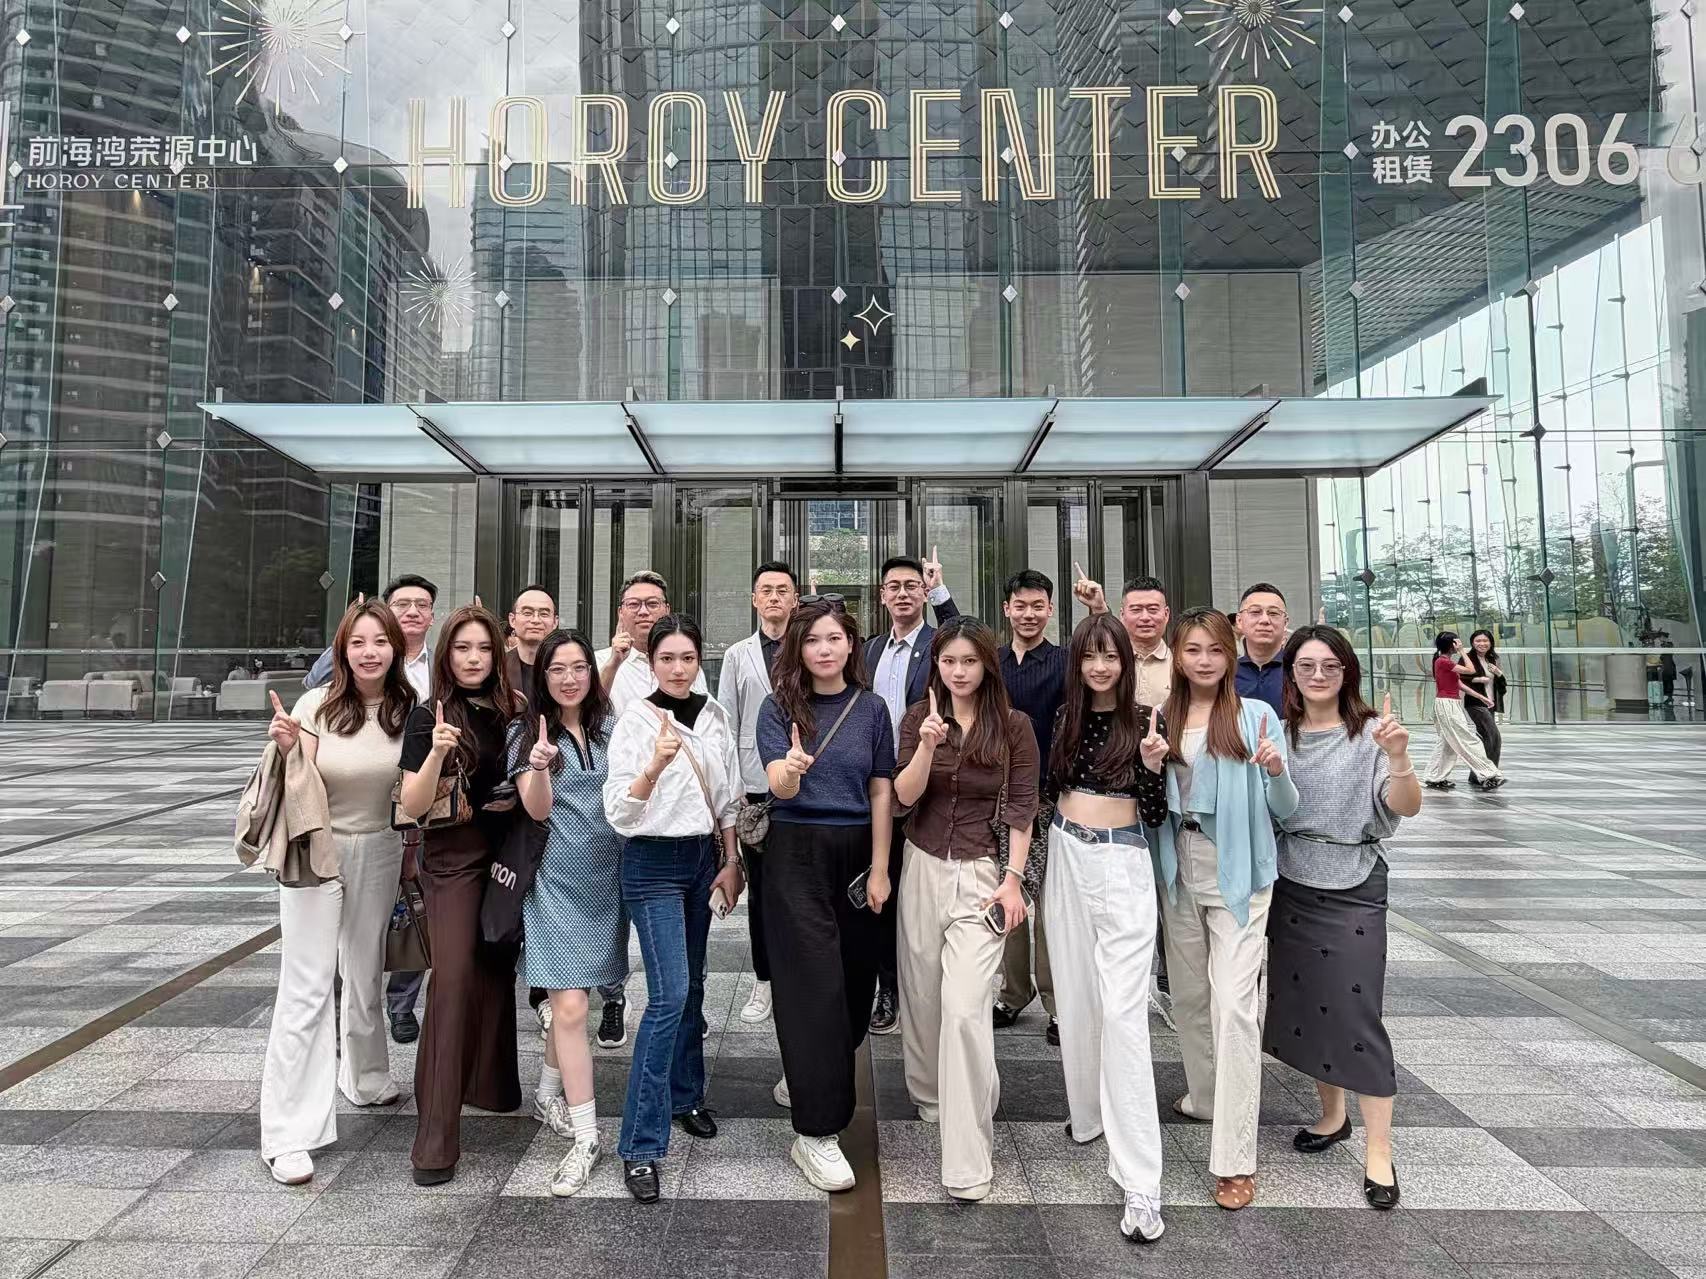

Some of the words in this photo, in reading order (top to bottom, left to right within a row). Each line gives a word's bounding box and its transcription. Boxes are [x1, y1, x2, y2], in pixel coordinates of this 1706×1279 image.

[407, 89, 786, 208] HOROY
[826, 85, 1281, 202] CENTER
[1371, 120, 1432, 149] 办公
[1444, 112, 1640, 187] 2306
[28, 135, 257, 166] 前海鸿荣源中心
[27, 173, 104, 189] HOROY
[114, 173, 210, 189] CENTER
[1372, 155, 1433, 184] 租赁
